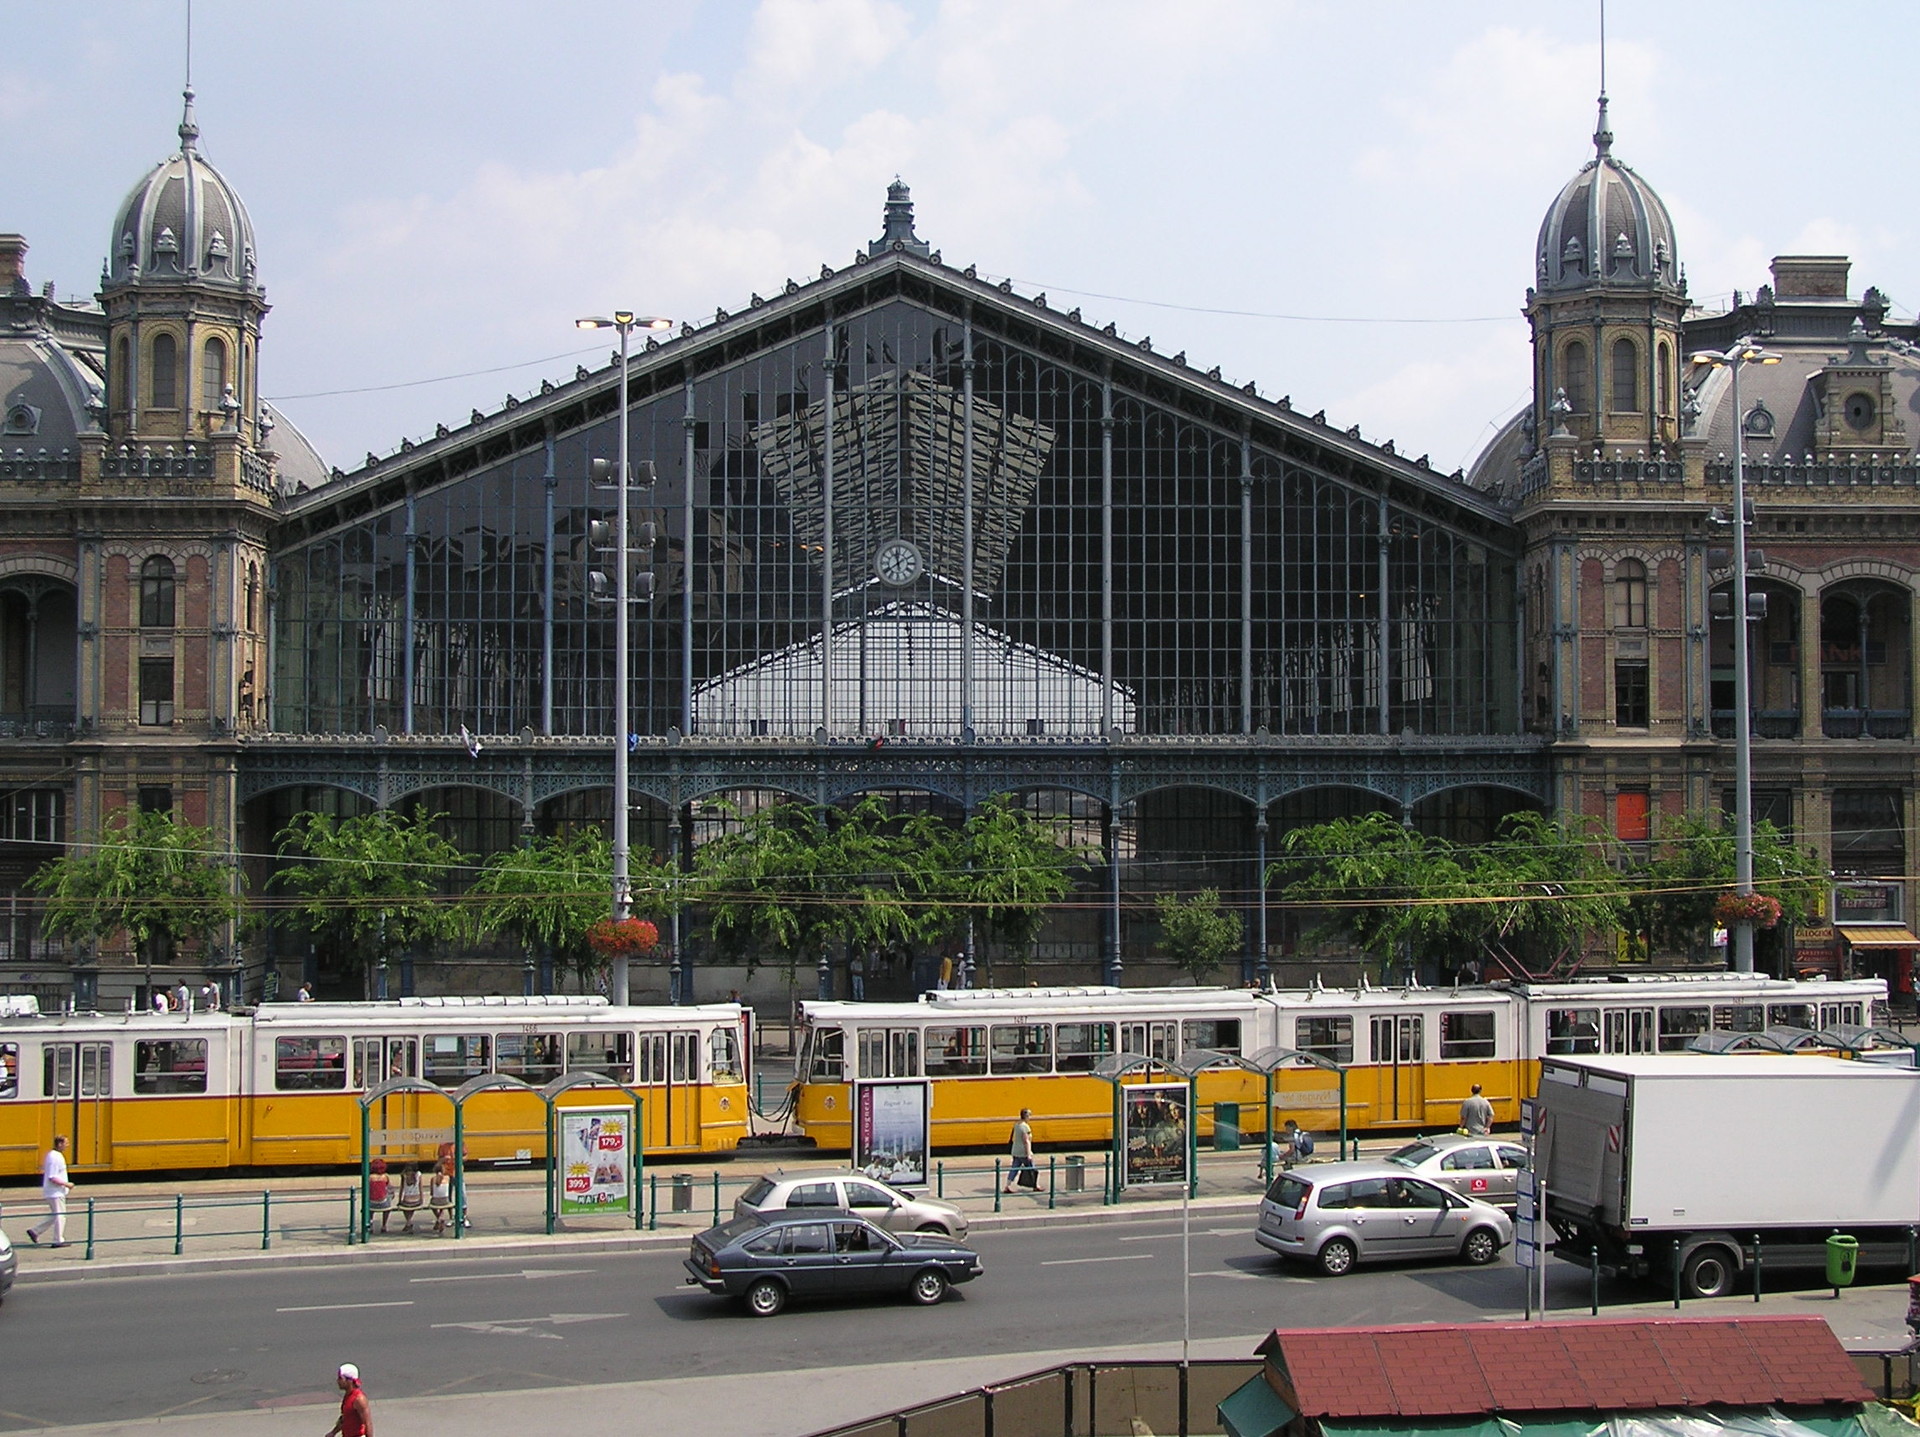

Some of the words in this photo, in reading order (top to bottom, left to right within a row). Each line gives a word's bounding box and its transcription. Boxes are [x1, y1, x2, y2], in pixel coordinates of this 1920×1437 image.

[862, 1086, 870, 1156] www.rogner.hu
[601, 1138, 621, 1147] 179,-
[577, 1192, 615, 1204] MATCH
